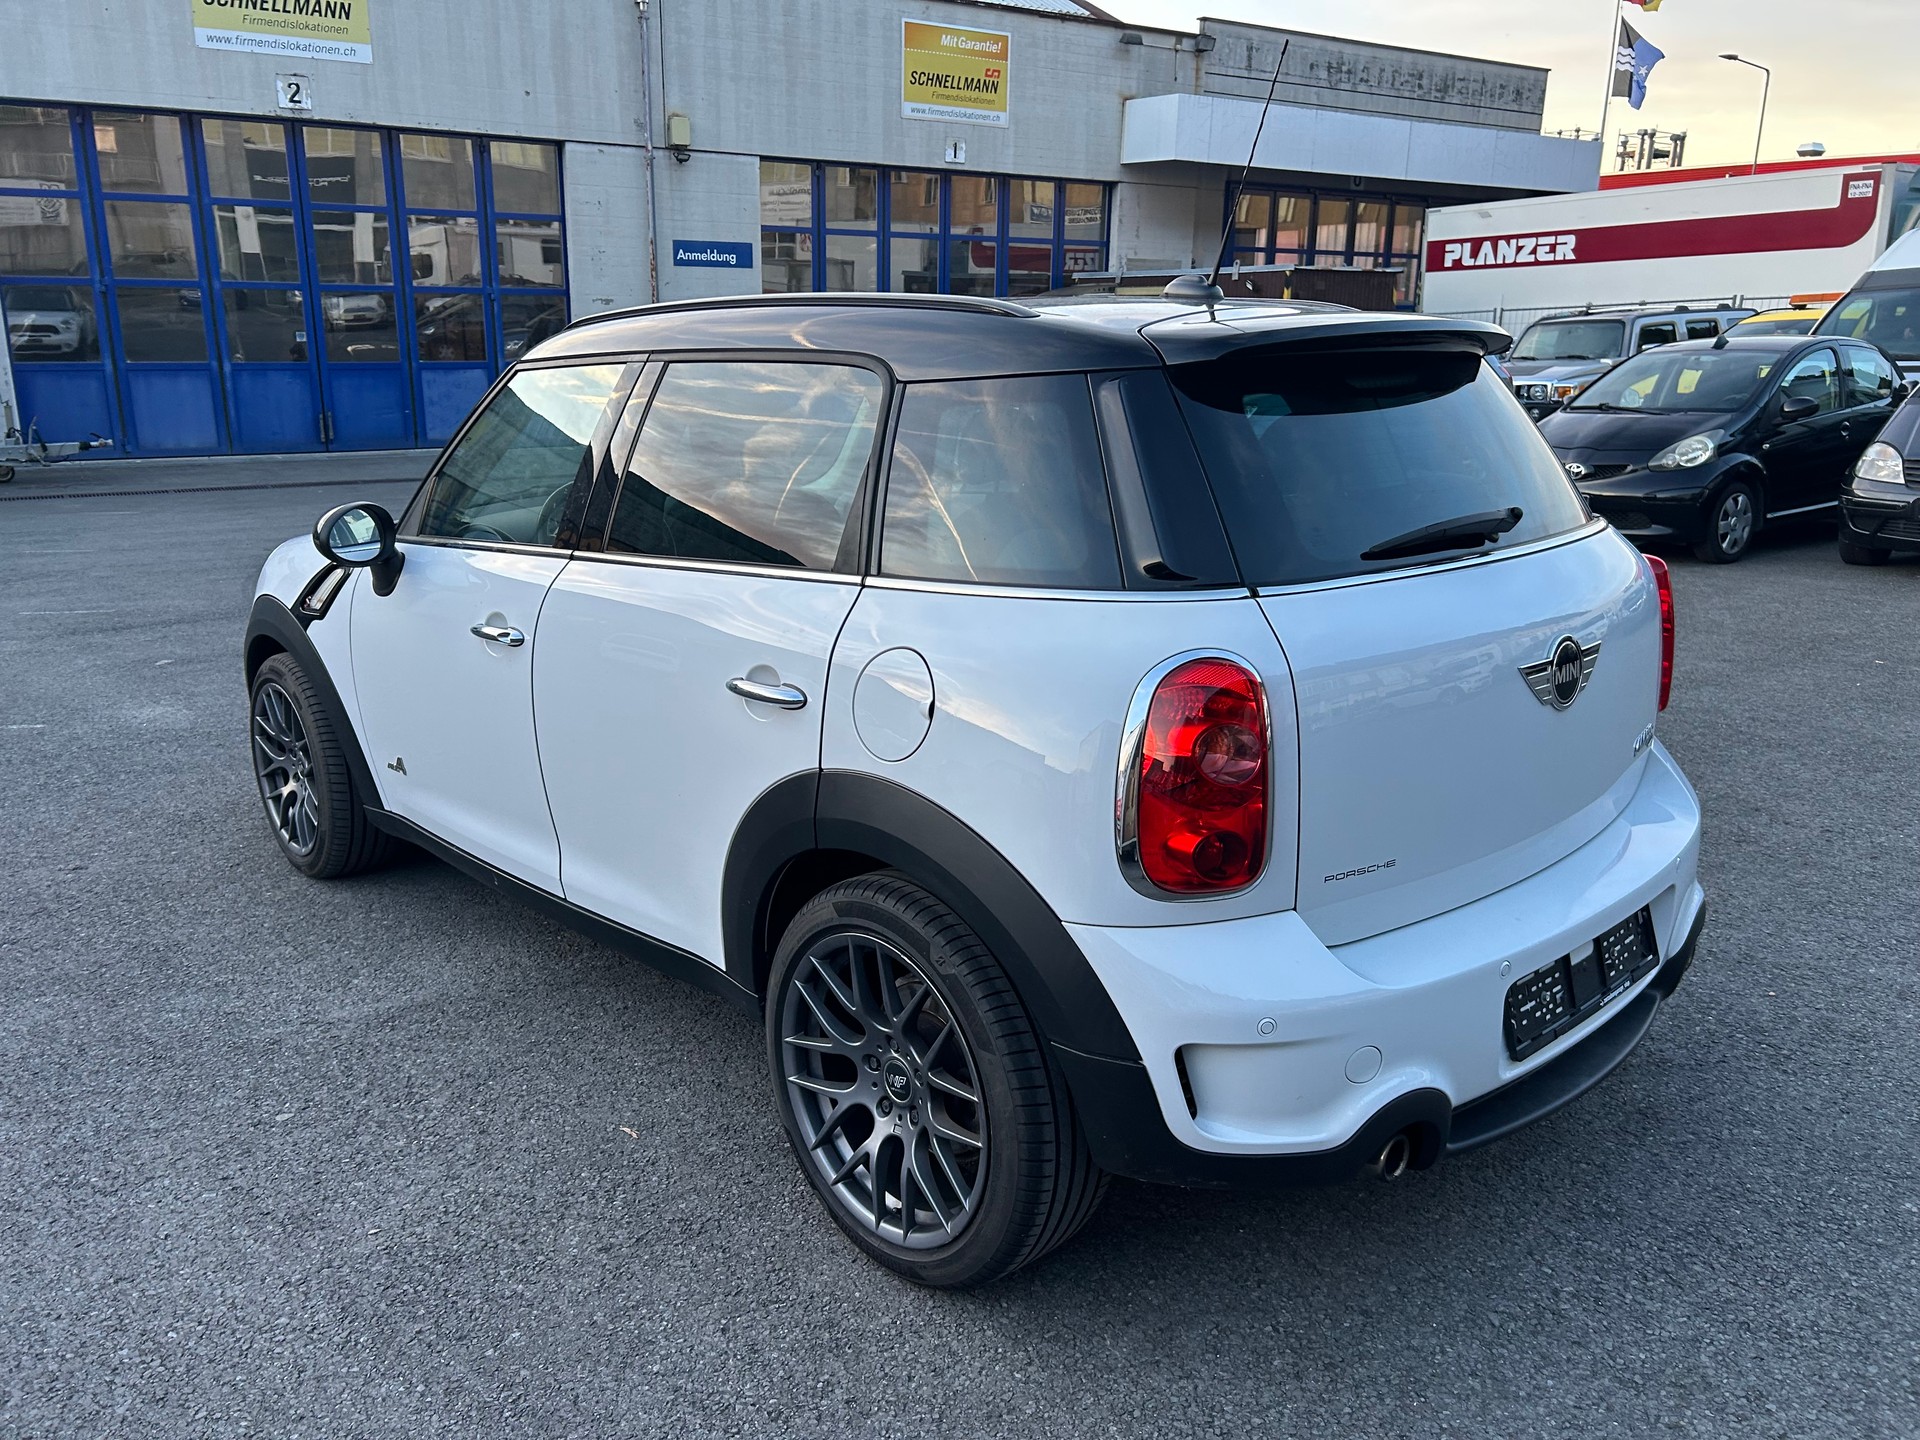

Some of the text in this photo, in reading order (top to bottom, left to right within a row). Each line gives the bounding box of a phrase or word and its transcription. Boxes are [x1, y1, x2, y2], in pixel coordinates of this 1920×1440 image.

[242, 14, 349, 35] Firmendislokationen
[206, 33, 356, 57] www.firmendislokationen.ch
[941, 34, 1002, 53] Mit Garantie!
[909, 70, 999, 94] SCHNELLMANN
[287, 82, 302, 104] 2
[931, 91, 995, 105] Firmendislokationen
[910, 106, 1001, 122] www.firmendislokationen.ch
[952, 142, 958, 159] 1
[676, 249, 737, 265] Anmeldung
[1443, 234, 1576, 268] PLANZER
[1554, 660, 1581, 685] MINI
[1323, 859, 1397, 884] PORSCHE
